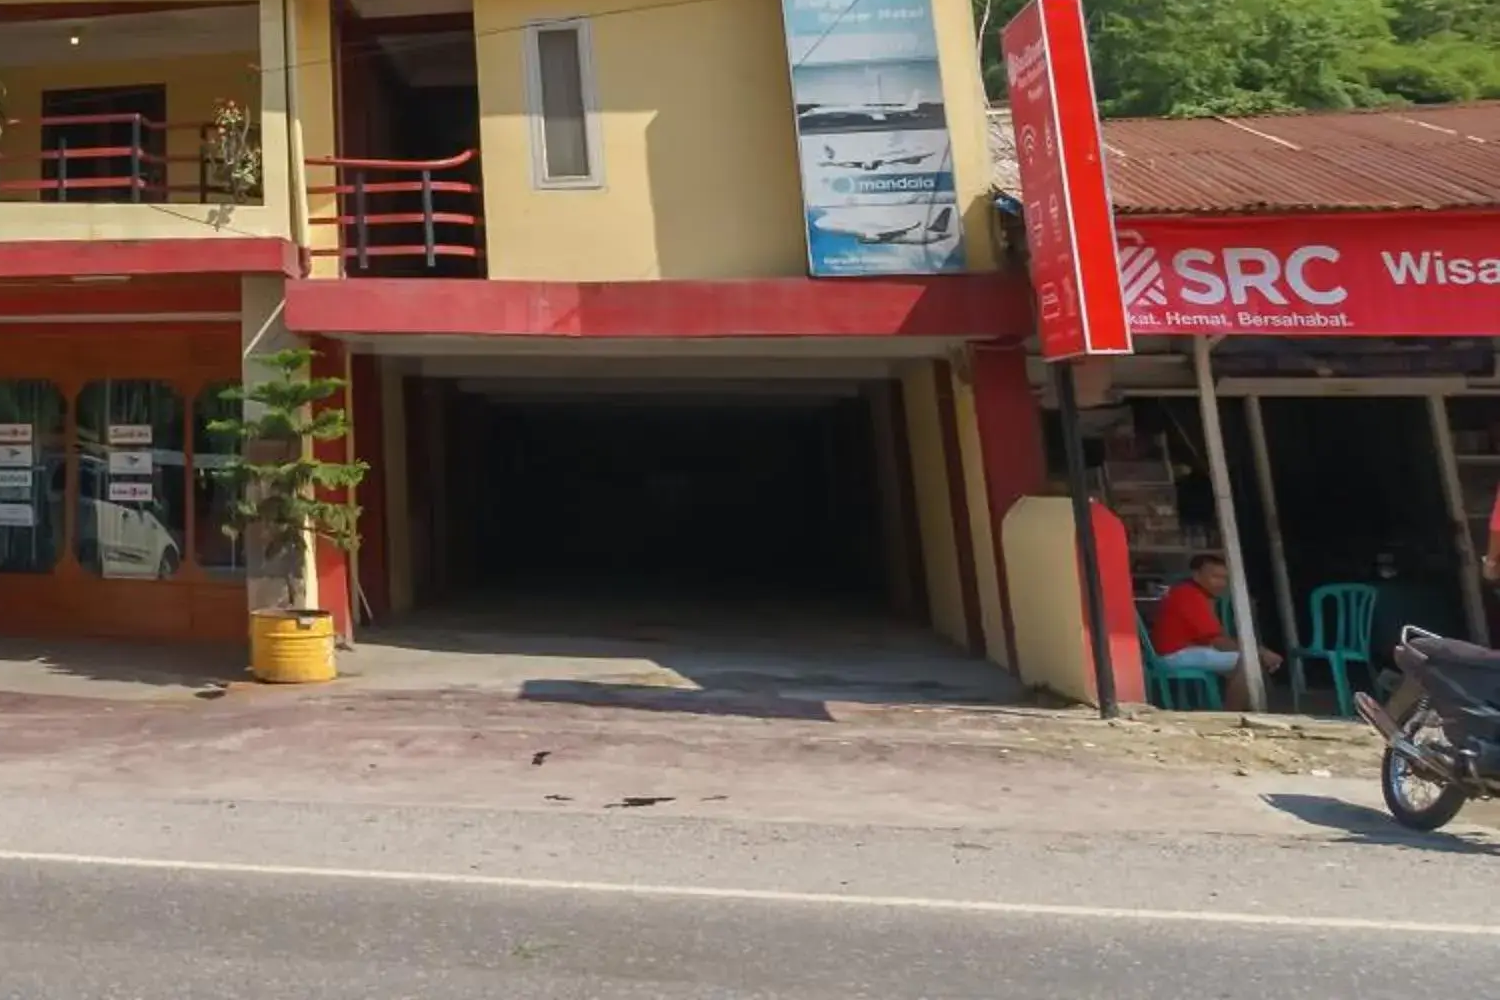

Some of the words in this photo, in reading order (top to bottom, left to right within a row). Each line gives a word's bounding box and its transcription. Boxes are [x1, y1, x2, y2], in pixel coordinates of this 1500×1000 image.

[1172, 245, 1349, 306] SRC
[1380, 250, 1500, 286] Wisa
[1237, 311, 1356, 328] Bersahabat.
